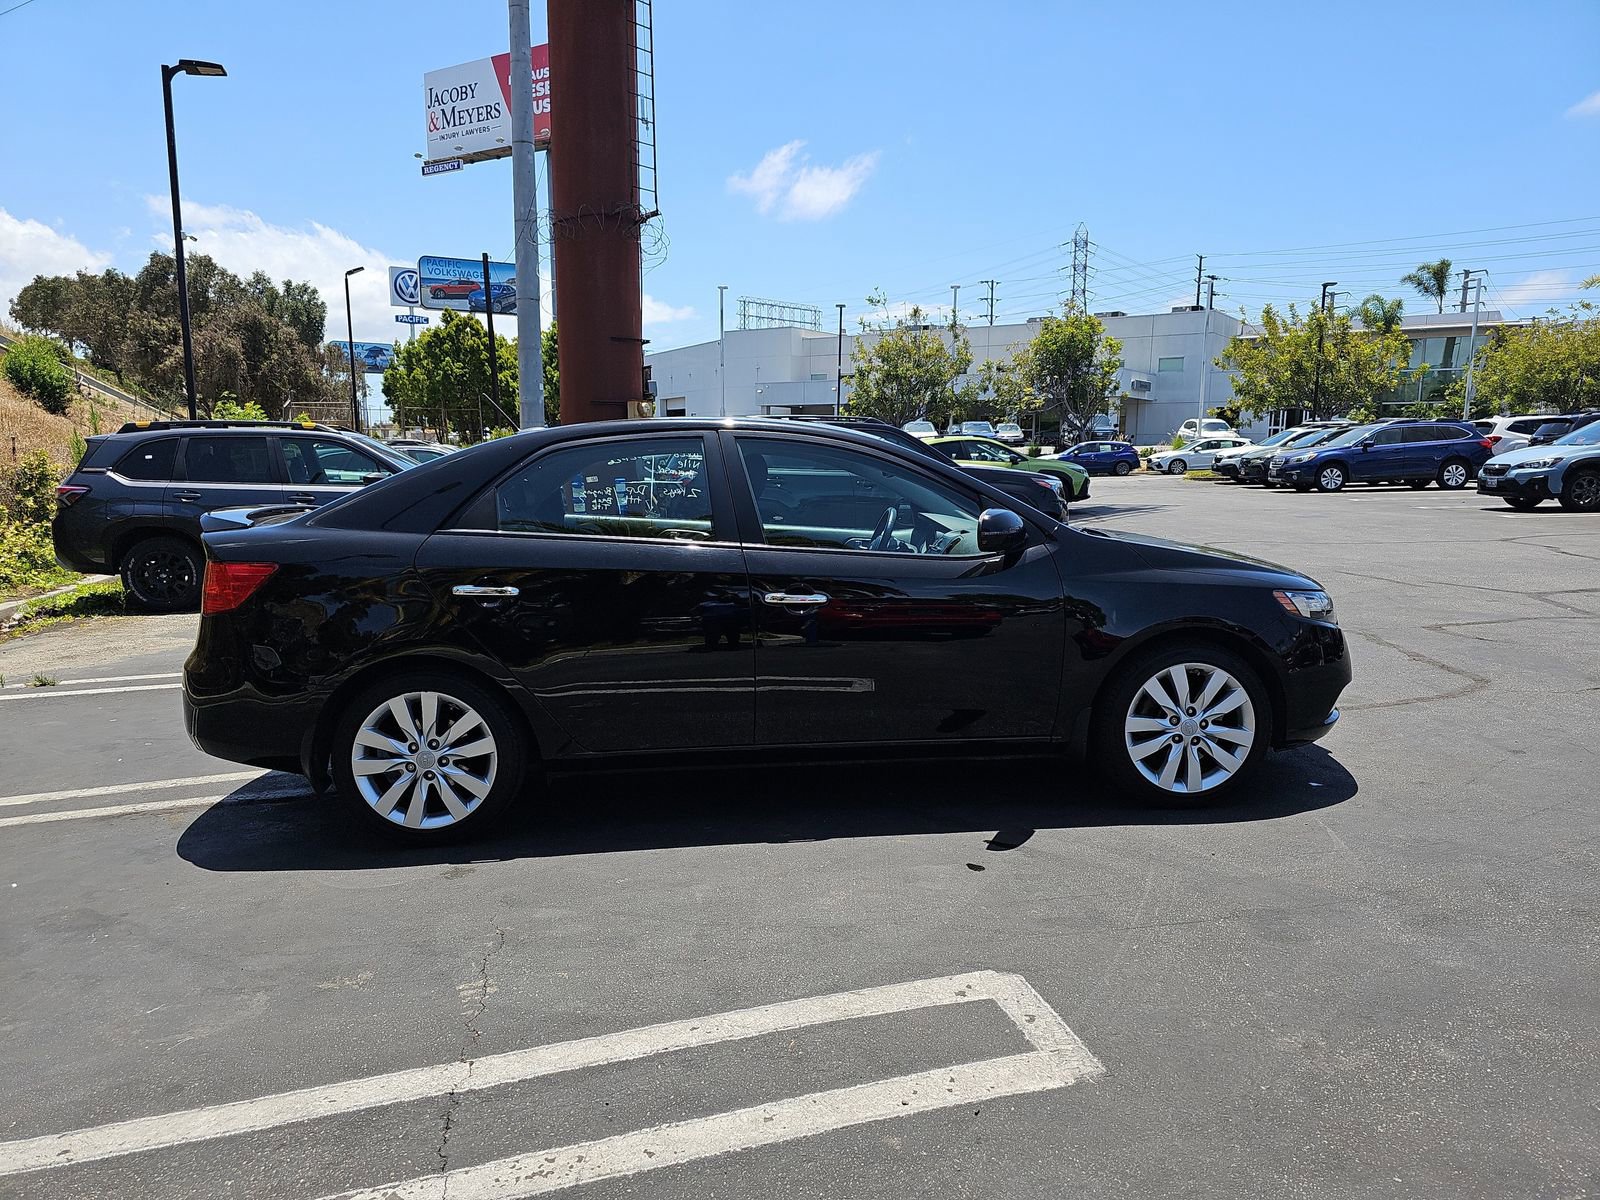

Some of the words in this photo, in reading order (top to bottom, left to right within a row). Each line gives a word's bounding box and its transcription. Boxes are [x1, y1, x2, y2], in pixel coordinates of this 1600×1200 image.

[427, 82, 478, 109] JACOBY
[439, 131, 460, 141] INJURY
[461, 125, 490, 137] LAWYERS
[423, 162, 459, 175] REGENCY
[426, 259, 461, 269] PACIFIC
[397, 315, 428, 324] PACIFIC
